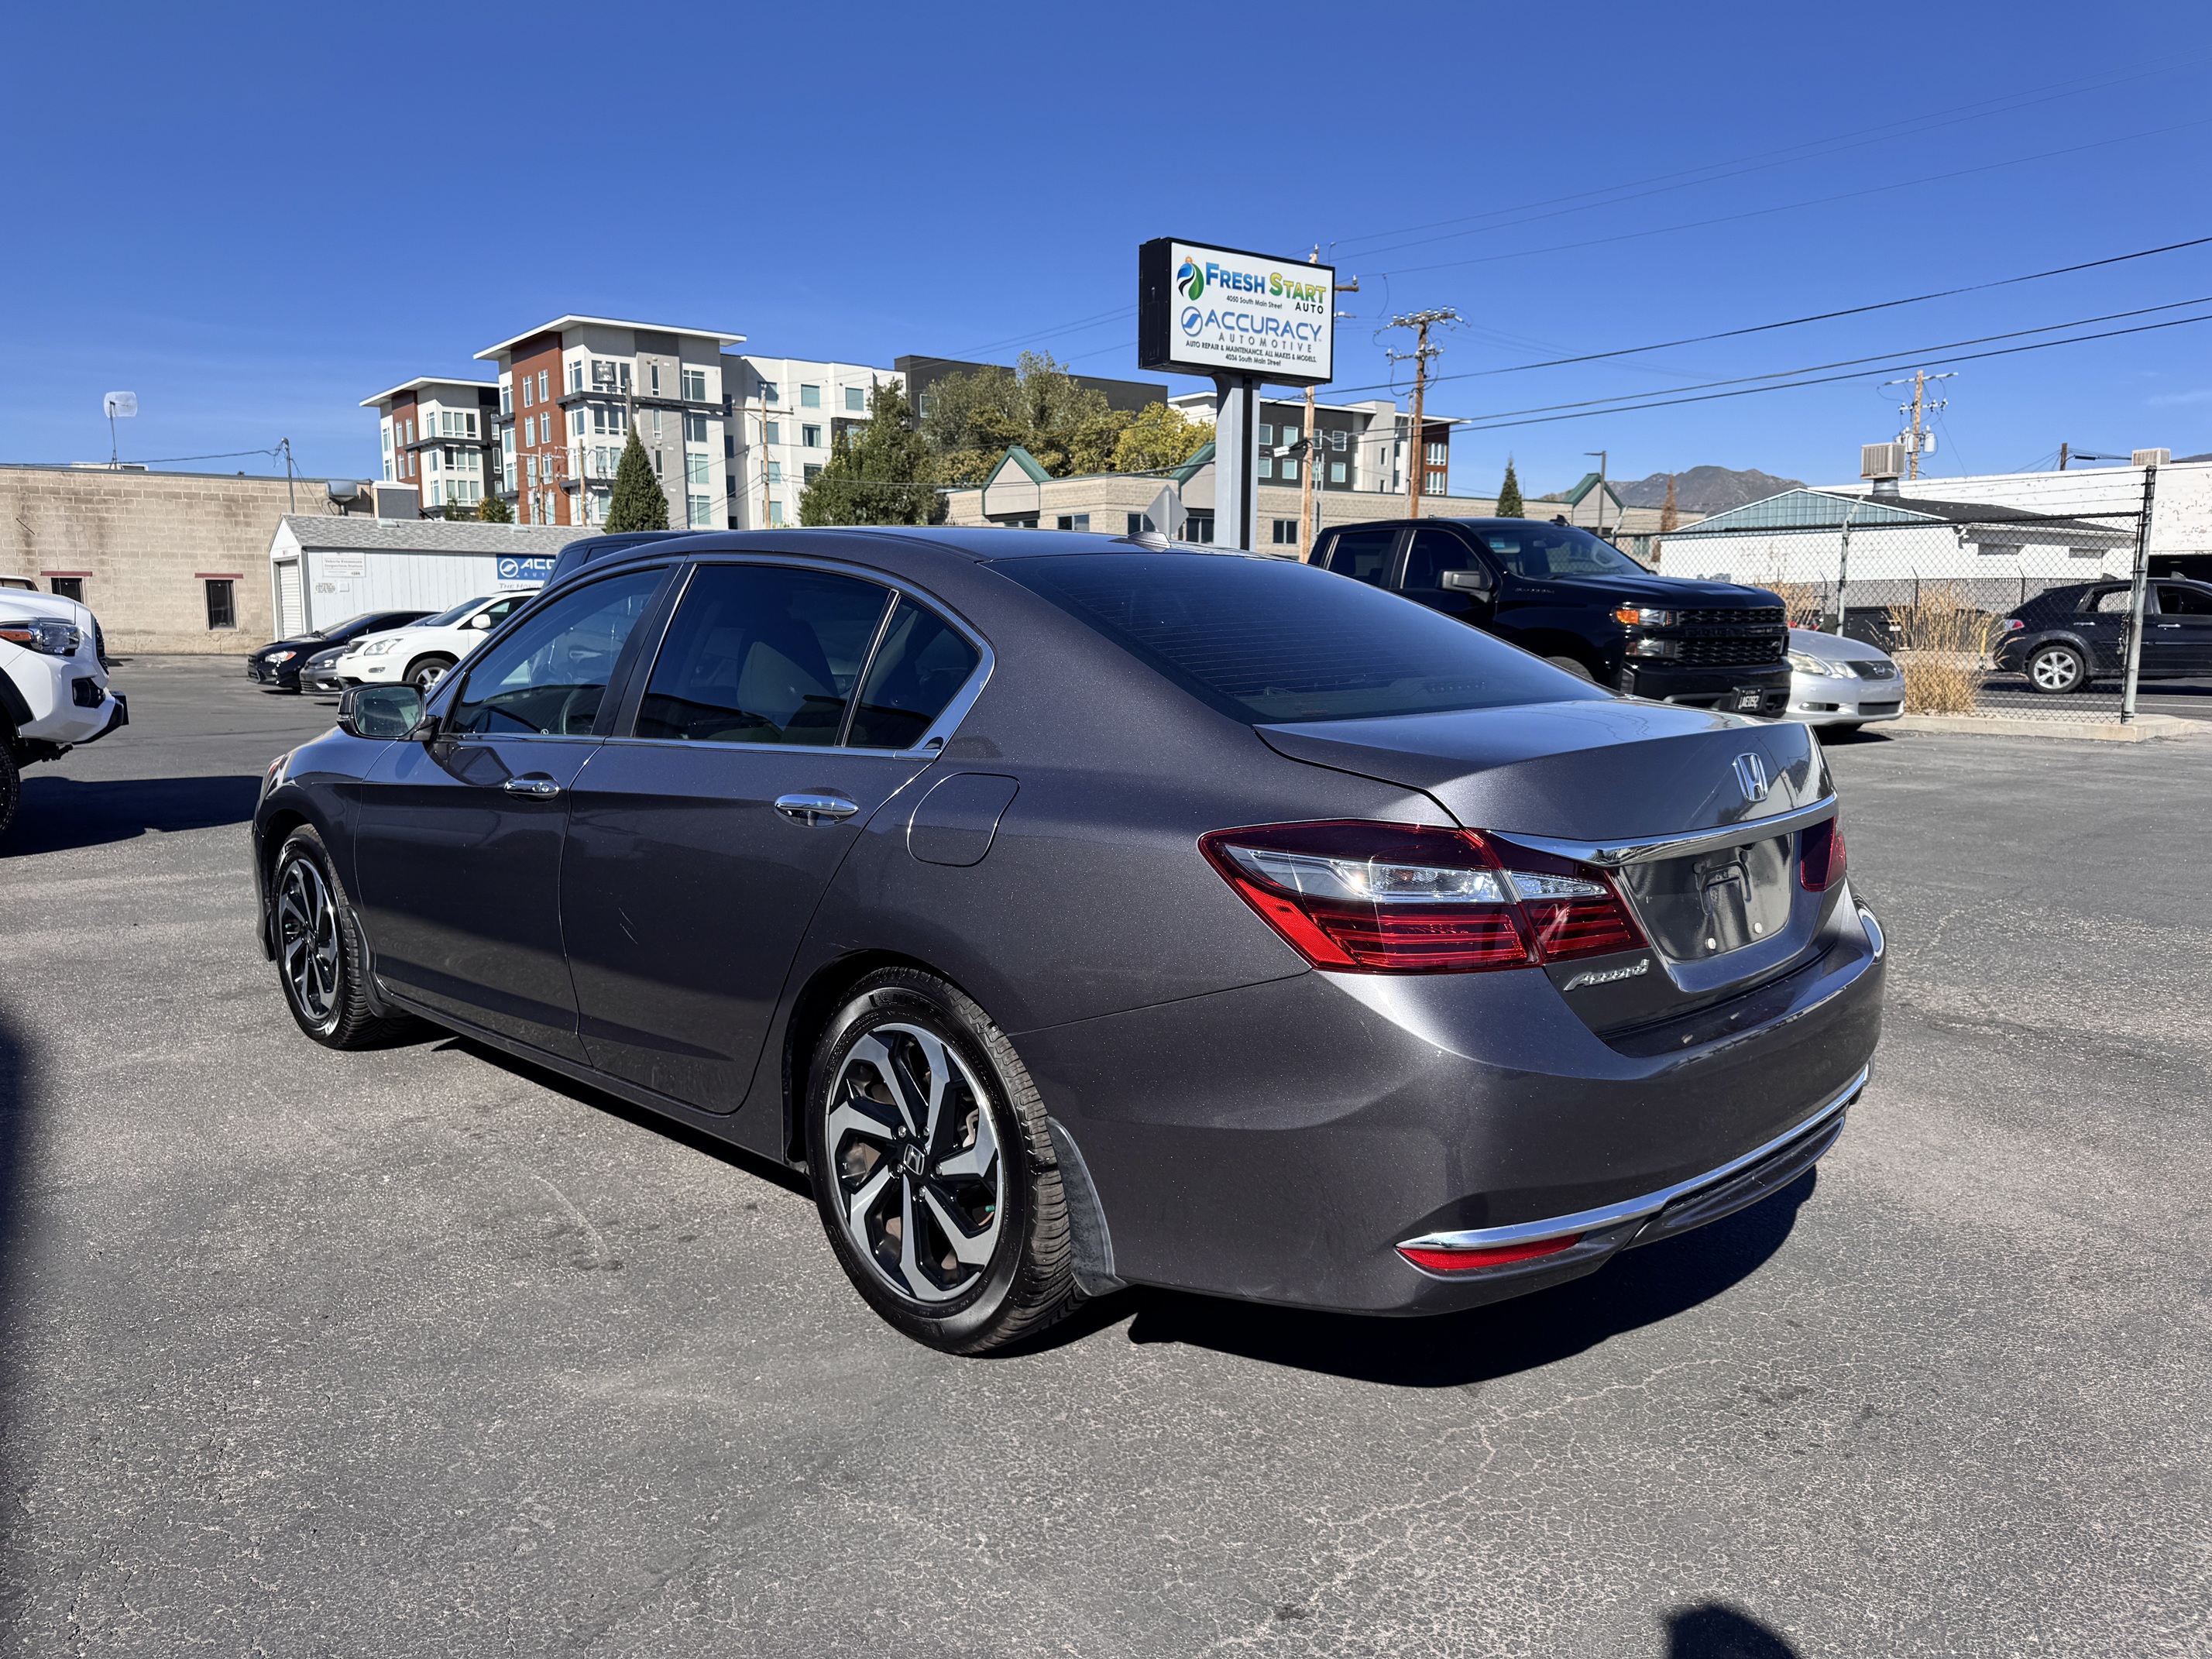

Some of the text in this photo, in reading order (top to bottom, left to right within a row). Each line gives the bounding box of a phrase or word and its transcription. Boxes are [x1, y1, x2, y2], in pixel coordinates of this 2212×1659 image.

[1206, 262, 1326, 304] FRESH START
[1295, 302, 1324, 314] AUTO
[1204, 309, 1322, 342] ACCURACY
[1201, 342, 1219, 351] REPAIR
[1265, 349, 1273, 358] ALL
[1274, 352, 1291, 360] MAKES
[1218, 332, 1311, 353] AUTOMOTIVE
[1563, 959, 1650, 991] Accord
